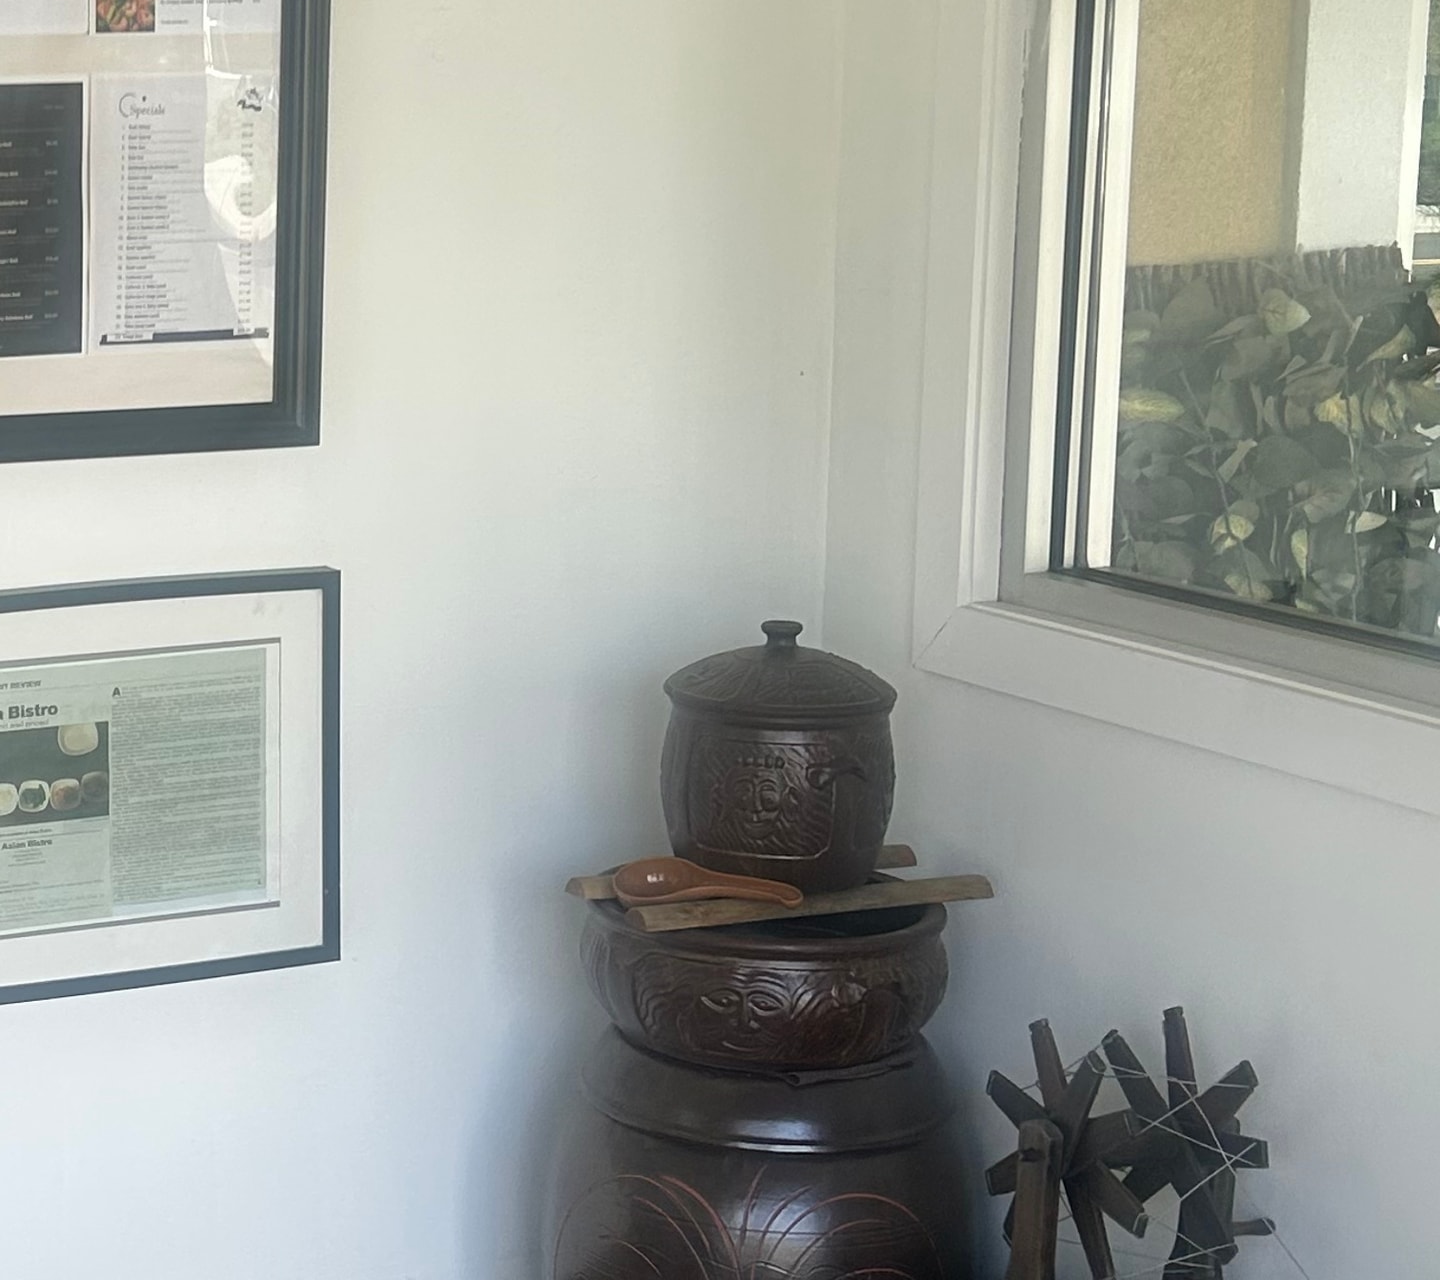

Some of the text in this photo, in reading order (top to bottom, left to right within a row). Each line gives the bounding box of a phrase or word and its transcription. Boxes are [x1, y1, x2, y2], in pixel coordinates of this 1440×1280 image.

[10, 680, 42, 690] REVIEW
[8, 704, 59, 720] Bistro
[1, 841, 26, 851] Asian
